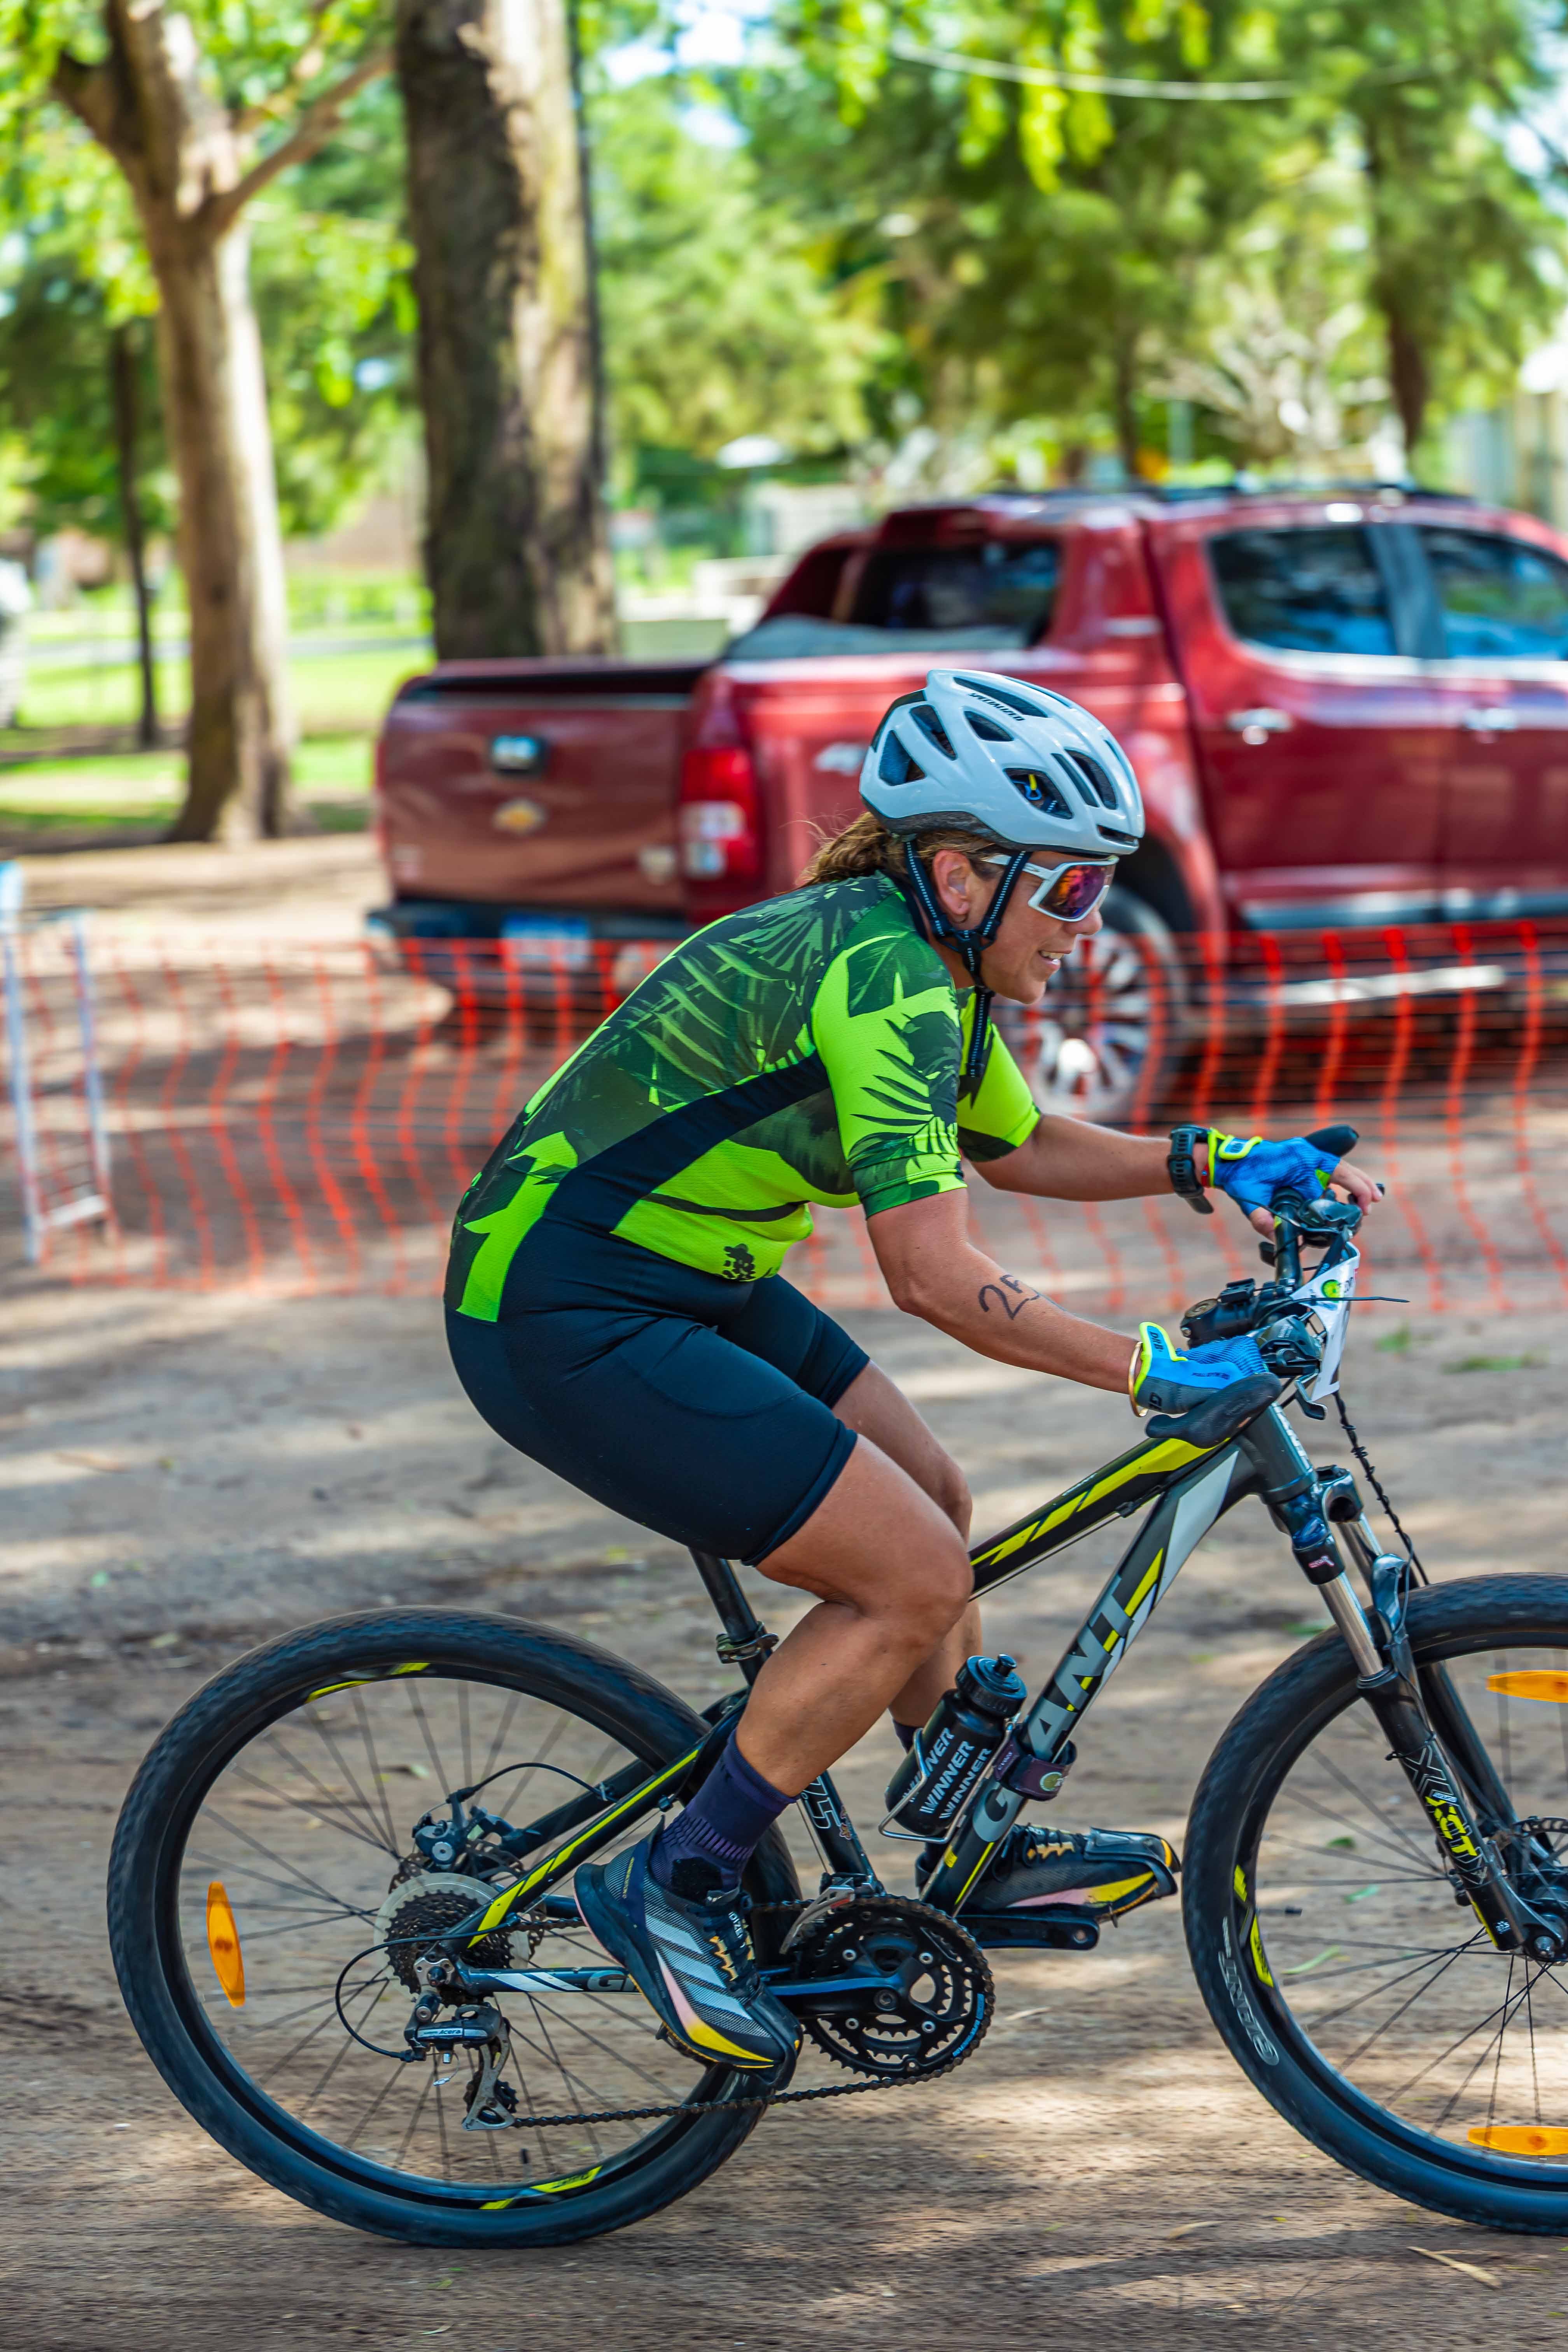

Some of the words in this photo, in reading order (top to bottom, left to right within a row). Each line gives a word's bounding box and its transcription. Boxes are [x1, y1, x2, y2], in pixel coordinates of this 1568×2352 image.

[969, 693, 1025, 721] SPECIALIZED
[973, 1574, 1135, 1843] GANT
[920, 1740, 975, 1814] WINNER
[939, 1748, 992, 1819] WINNER
